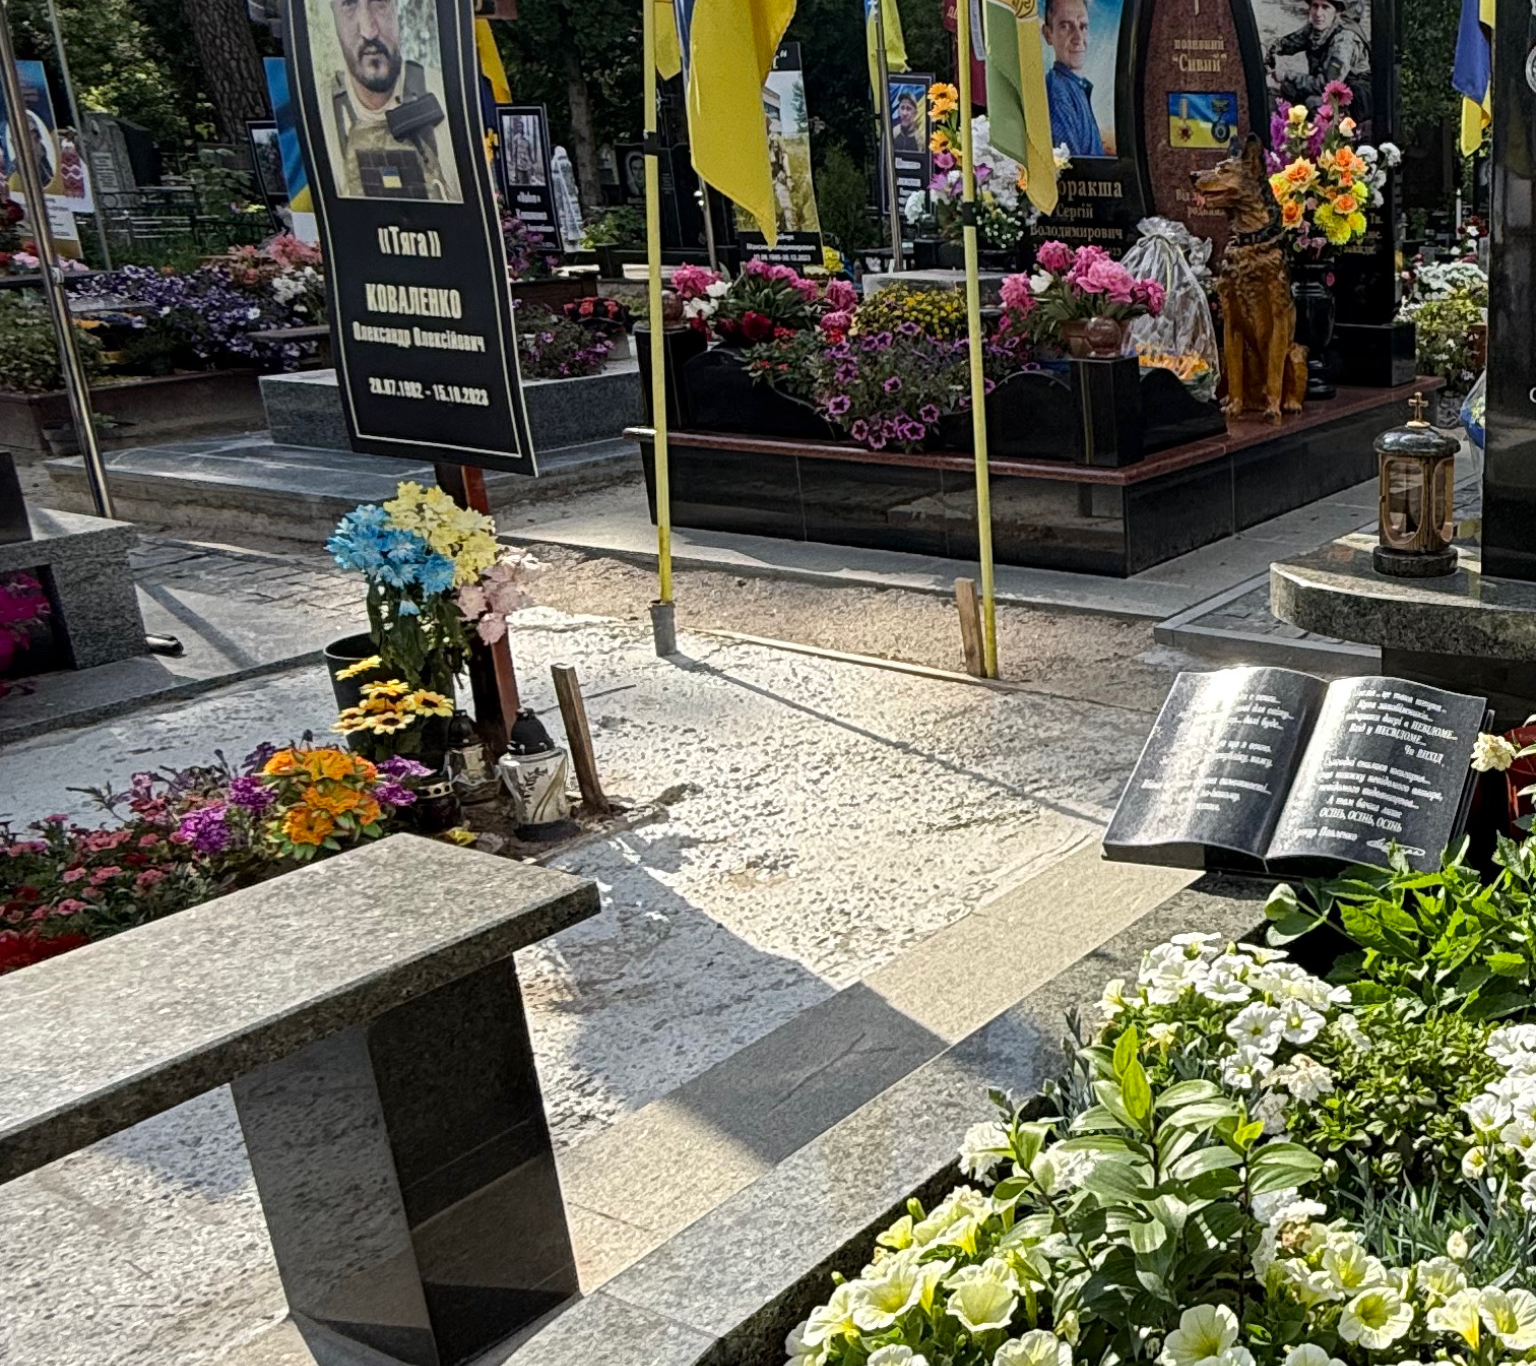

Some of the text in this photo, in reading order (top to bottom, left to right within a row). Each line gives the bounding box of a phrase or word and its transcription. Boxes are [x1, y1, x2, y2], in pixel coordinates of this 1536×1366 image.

[365, 283, 463, 319] КОВАЛЕНКО
[352, 321, 486, 352] Олександр Олексійович
